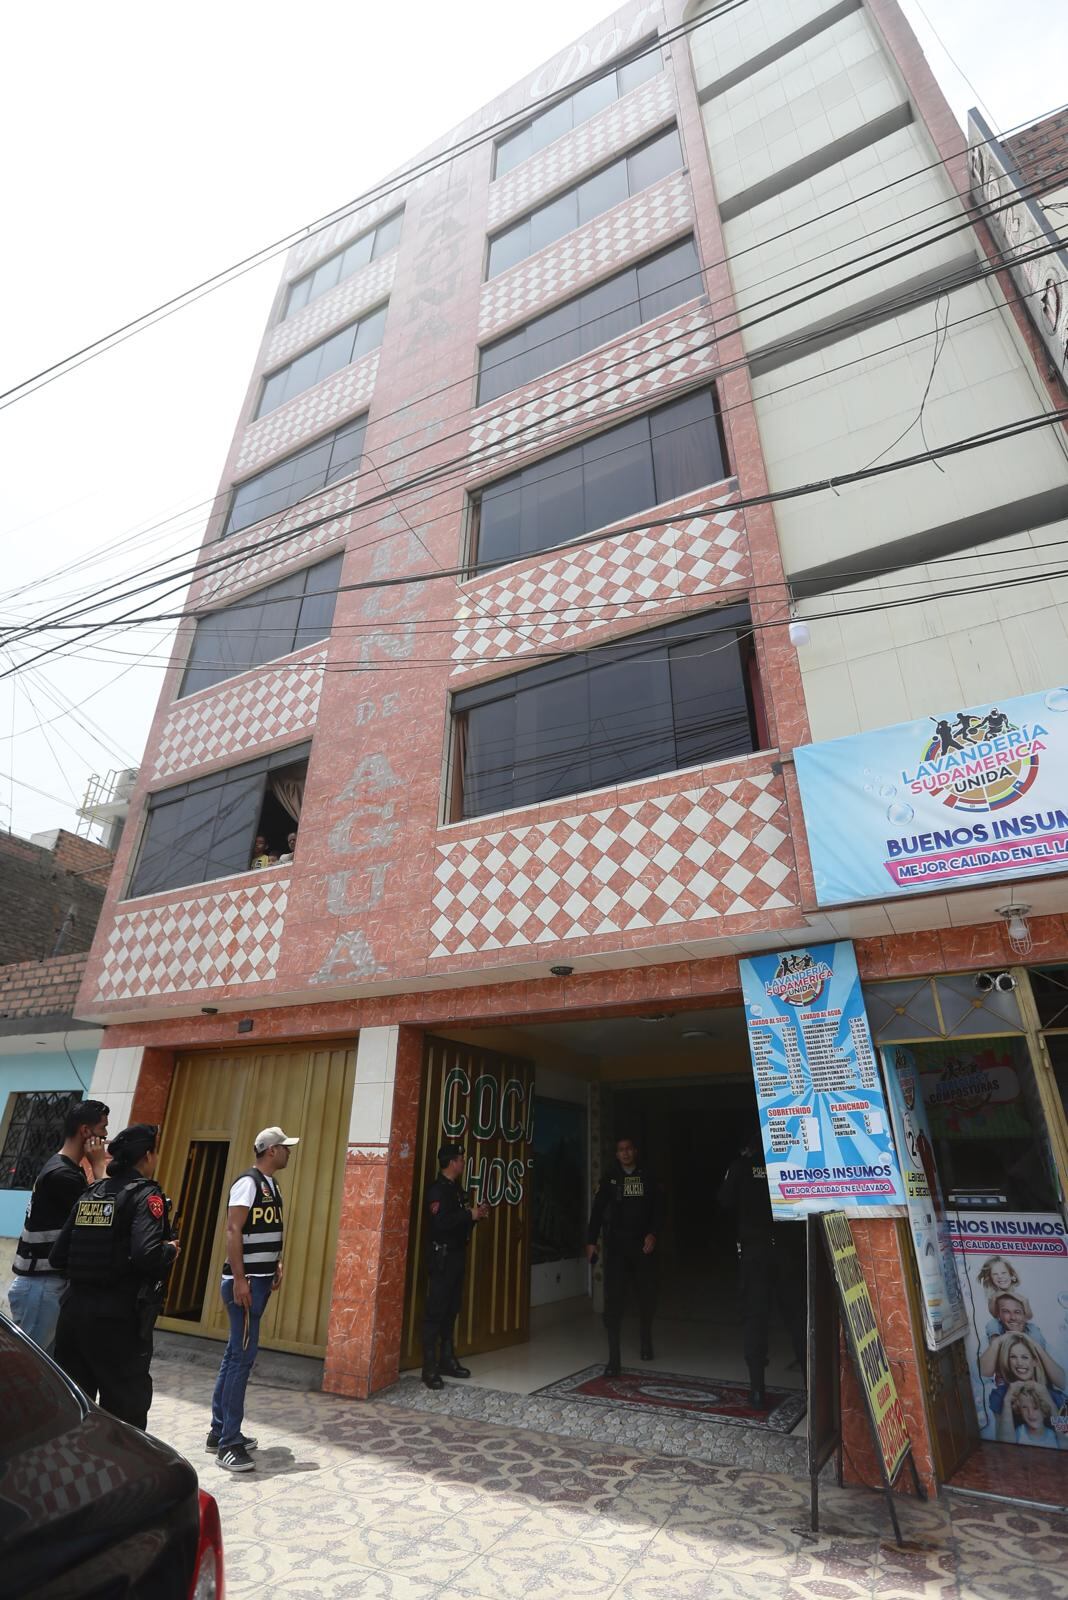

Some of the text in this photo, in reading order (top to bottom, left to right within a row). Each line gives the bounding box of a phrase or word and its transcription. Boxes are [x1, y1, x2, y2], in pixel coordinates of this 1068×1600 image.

[354, 690, 401, 727] DE
[902, 724, 1049, 785] LAVANDERÍA
[911, 739, 1047, 794] SUDAMERICA
[954, 766, 1013, 793] UNIDA
[887, 823, 989, 857] BUENOS
[309, 752, 407, 984] AGUA
[899, 861, 948, 877] MEJOR
[949, 851, 1010, 872] CALIDAD
[1012, 846, 1032, 860] EN
[1035, 842, 1054, 857] EL
[766, 961, 829, 988] LAVANDERÍA
[766, 970, 833, 996] SUDAMERICA
[789, 984, 813, 997] UNIDA
[441, 1067, 535, 1144] COC
[831, 1101, 869, 1113] PLANCHADO
[466, 1157, 534, 1207] HOS
[780, 1164, 892, 1181] BUENOS INSUMOS
[785, 1183, 890, 1195] MEJOR CALIDAD EN EL LAVADO
[80, 1203, 103, 1215] POLICIA
[946, 1220, 1064, 1236] ENOS INSUMOS
[966, 1241, 1001, 1249] CALIDAD
[1001, 1242, 1014, 1250] EN
[1027, 1244, 1063, 1252] LAVADO
